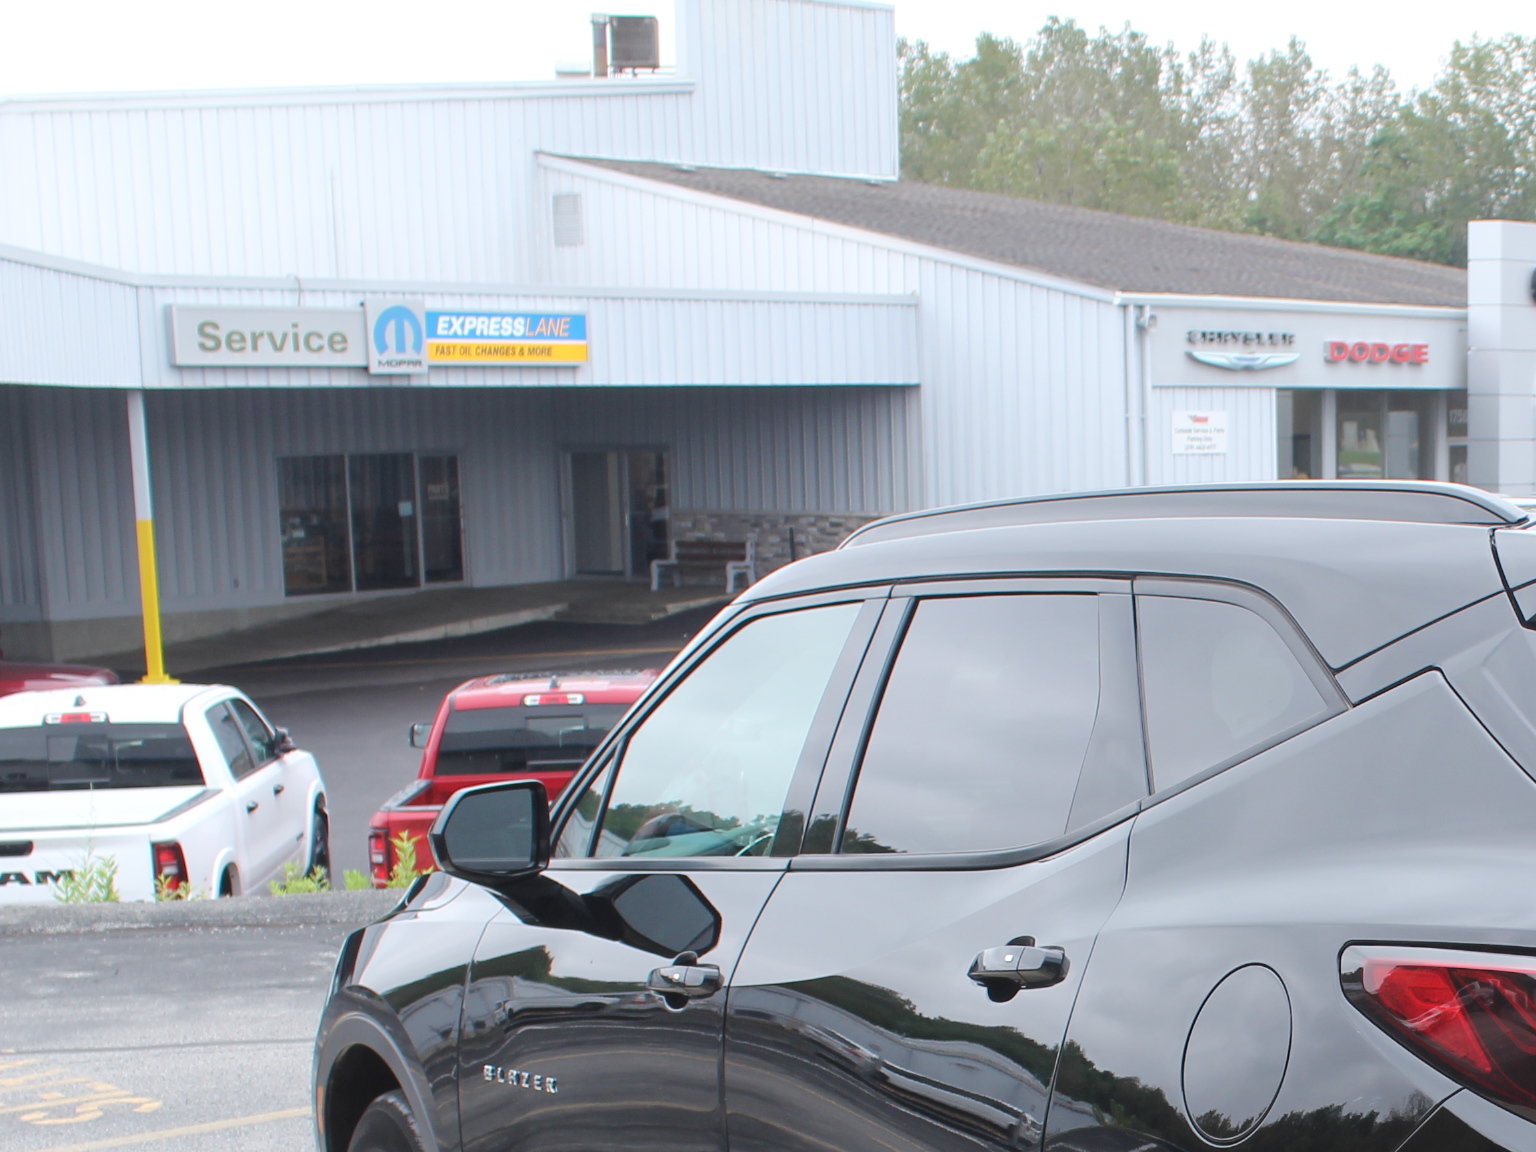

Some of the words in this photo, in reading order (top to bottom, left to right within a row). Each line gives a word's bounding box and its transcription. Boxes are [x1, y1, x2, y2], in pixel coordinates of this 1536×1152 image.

[197, 320, 348, 353] Service
[435, 345, 457, 356] FAST
[459, 345, 472, 356] OIL
[475, 345, 516, 357] CHANGES
[518, 346, 525, 357] &
[527, 346, 553, 357] MORE
[1326, 340, 1429, 364] DODGE
[378, 359, 422, 368] MOPAR
[0, 869, 76, 886] AM
[482, 1064, 558, 1094] BLAZER
